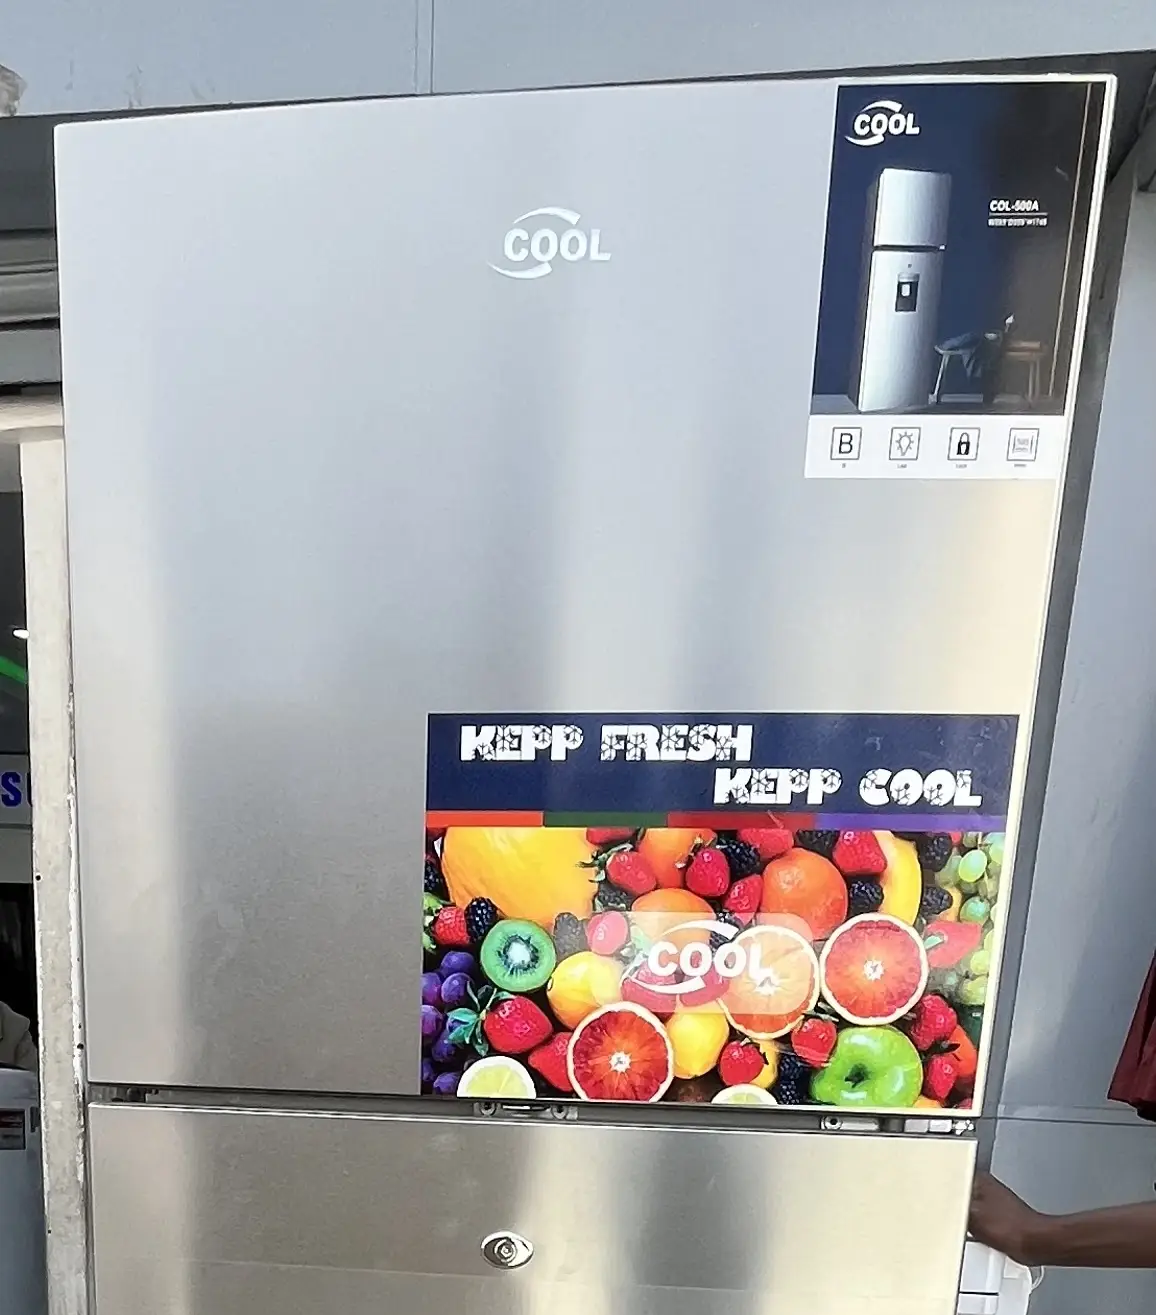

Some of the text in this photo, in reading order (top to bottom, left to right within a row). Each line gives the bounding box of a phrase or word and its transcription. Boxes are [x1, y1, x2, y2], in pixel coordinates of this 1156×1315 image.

[854, 111, 920, 136] COOL
[503, 227, 612, 263] COOL
[838, 432, 853, 455] B
[460, 724, 753, 762] KEPP FRESH
[713, 767, 983, 807] KEPP COOL
[647, 940, 774, 981] COOL
